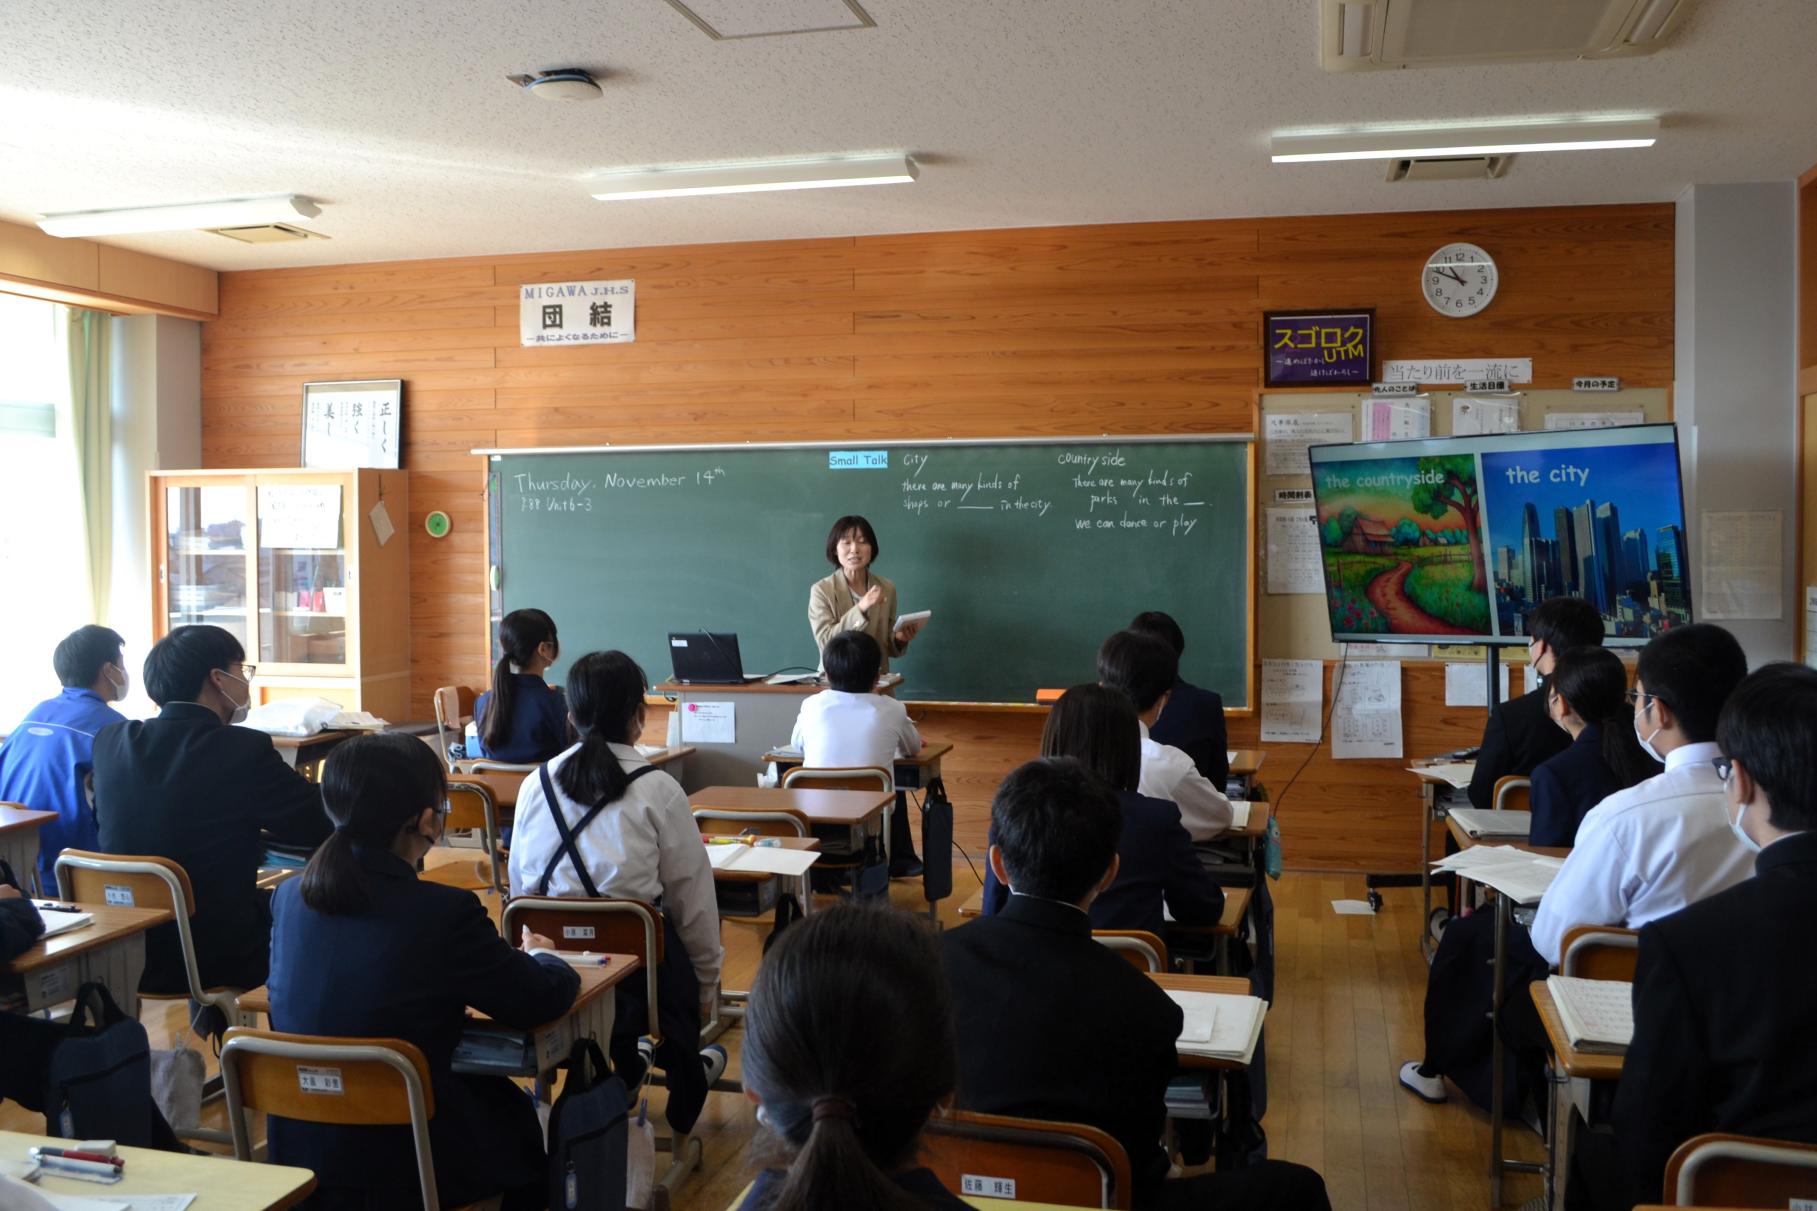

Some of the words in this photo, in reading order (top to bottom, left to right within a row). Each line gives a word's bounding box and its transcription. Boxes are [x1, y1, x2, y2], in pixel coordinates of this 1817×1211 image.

[1456, 253, 1464, 261] 12
[1432, 276, 1439, 285] 9
[1481, 276, 1487, 284] 3
[524, 286, 587, 299] MIGAWA
[1436, 288, 1442, 296] 8
[1456, 299, 1462, 307] 6
[542, 302, 613, 329] 団結
[1275, 326, 1363, 348] スゴロク
[1323, 344, 1364, 362] UTM
[1391, 363, 1520, 381] 当たり前を一流に
[830, 456, 859, 466] Small
[864, 455, 888, 465] Talk
[604, 472, 686, 489] November
[696, 466, 725, 485] 14th
[1099, 478, 1114, 487] are
[1120, 478, 1144, 497] many
[1177, 472, 1192, 487] of
[1325, 474, 1350, 489] the
[1356, 469, 1445, 489] countryside
[1505, 466, 1541, 484] the
[1550, 465, 1590, 486] city
[932, 482, 947, 491] are
[951, 482, 974, 502] many
[978, 472, 1002, 490] kinds
[1008, 473, 1020, 490] of
[938, 500, 951, 508] or
[1091, 491, 1117, 512] parks
[1139, 495, 1150, 505] in
[1159, 494, 1179, 505] the
[1097, 519, 1115, 528] can
[1120, 511, 1148, 528] dance
[1154, 520, 1166, 528] or
[1173, 513, 1198, 536] play
